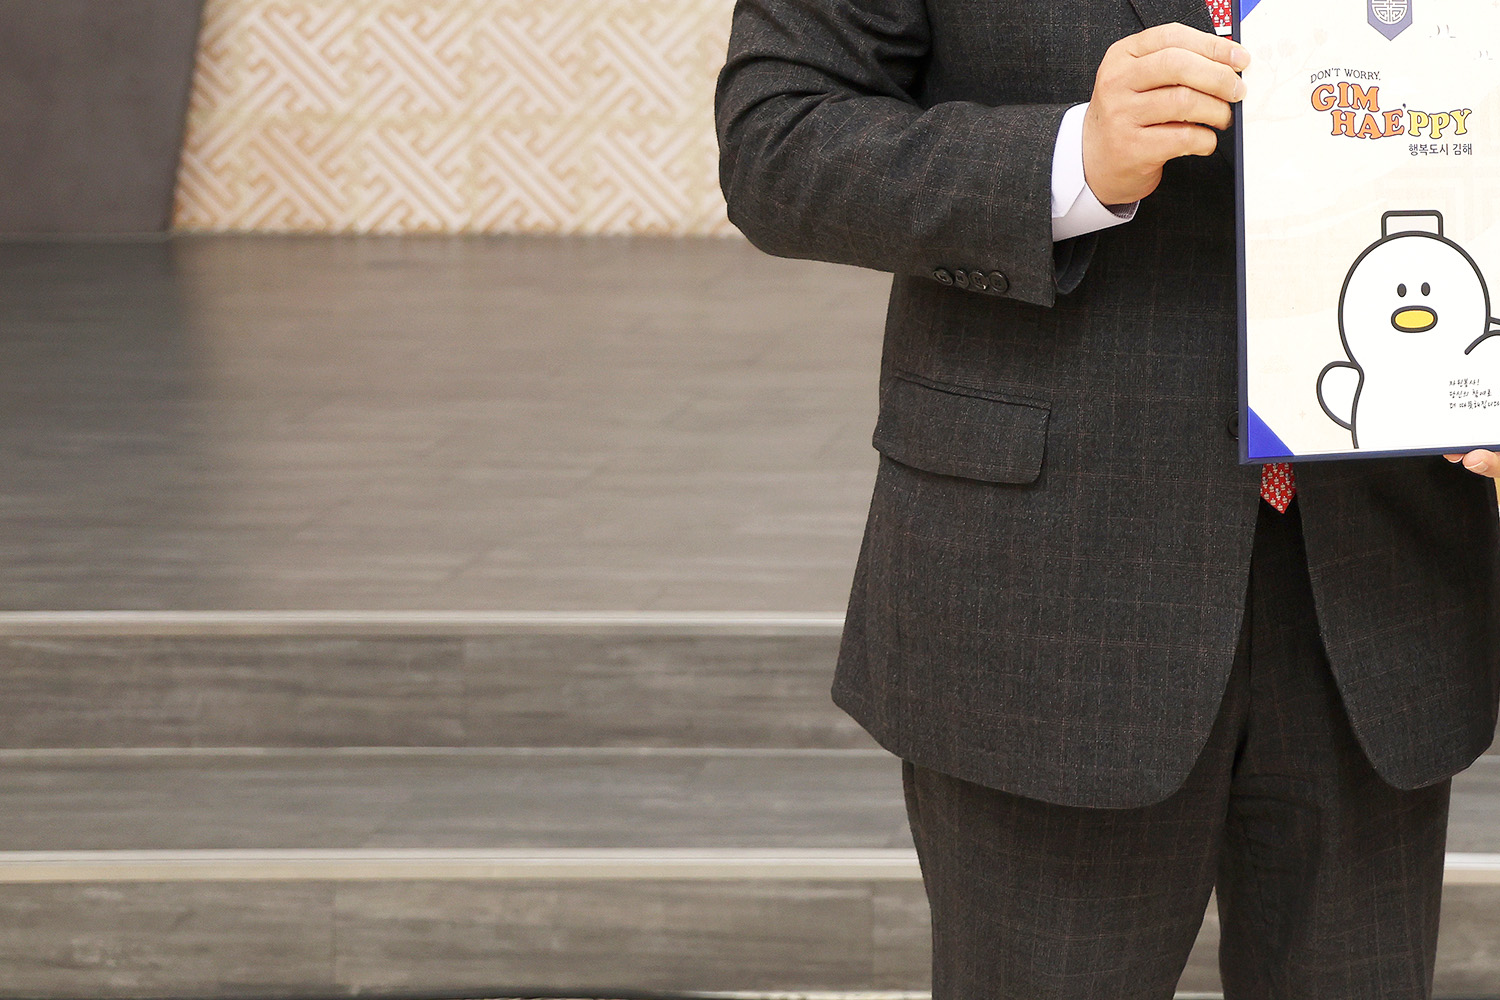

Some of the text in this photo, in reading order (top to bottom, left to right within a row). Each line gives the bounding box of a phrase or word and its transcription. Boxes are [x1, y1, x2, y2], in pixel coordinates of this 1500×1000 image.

[1310, 67, 1341, 84] DON'T
[1310, 81, 1380, 112] GIM
[1409, 144, 1472, 156] 행복도시 김해
